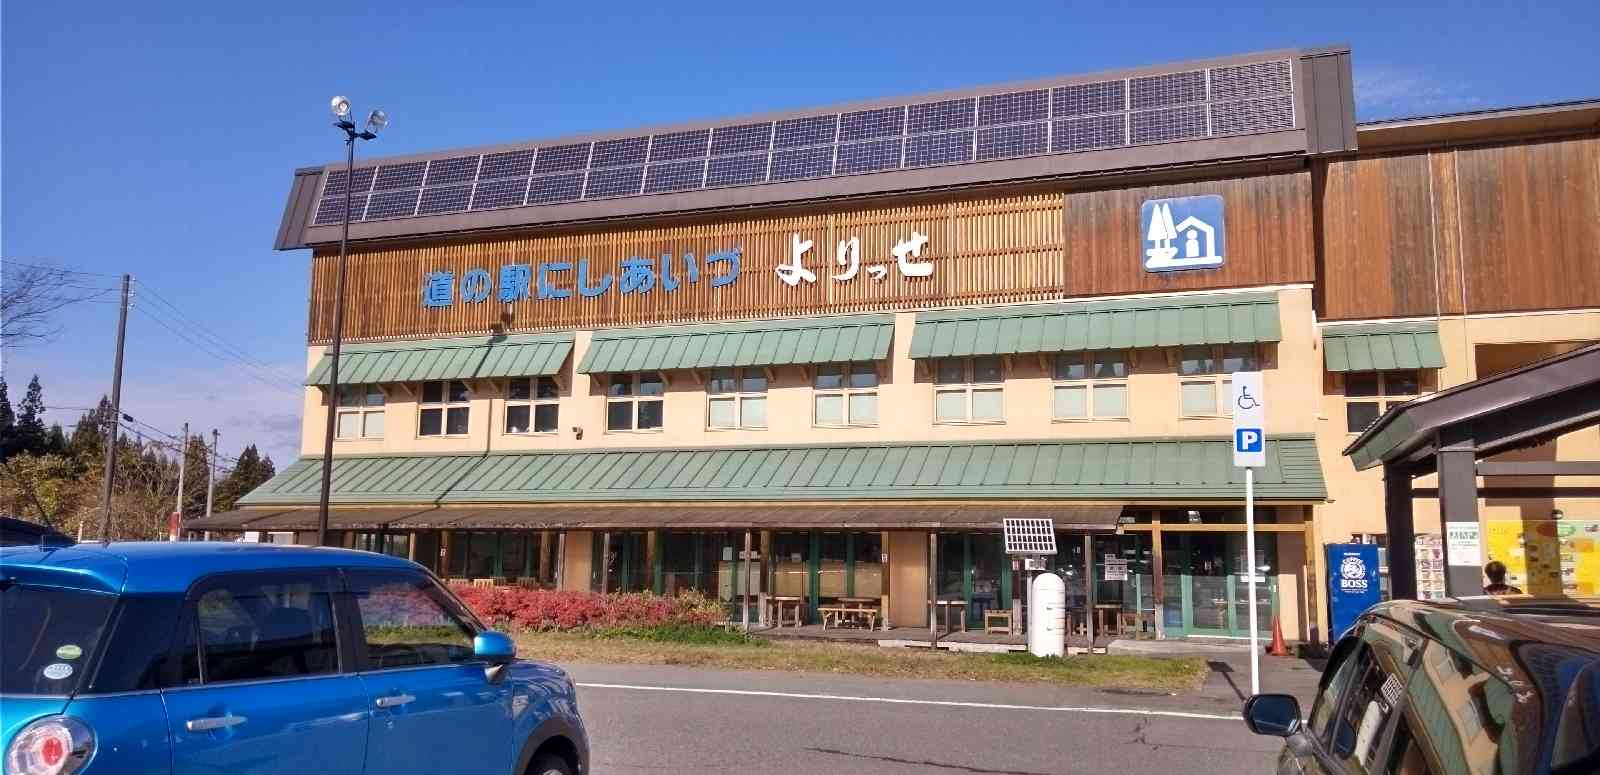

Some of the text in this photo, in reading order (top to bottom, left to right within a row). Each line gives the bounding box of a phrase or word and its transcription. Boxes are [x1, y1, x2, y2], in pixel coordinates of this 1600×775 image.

[423, 231, 935, 309] 道の駅にしあいづ よりっせ
[1242, 431, 1258, 450] P
[1340, 579, 1368, 589] BOSS
